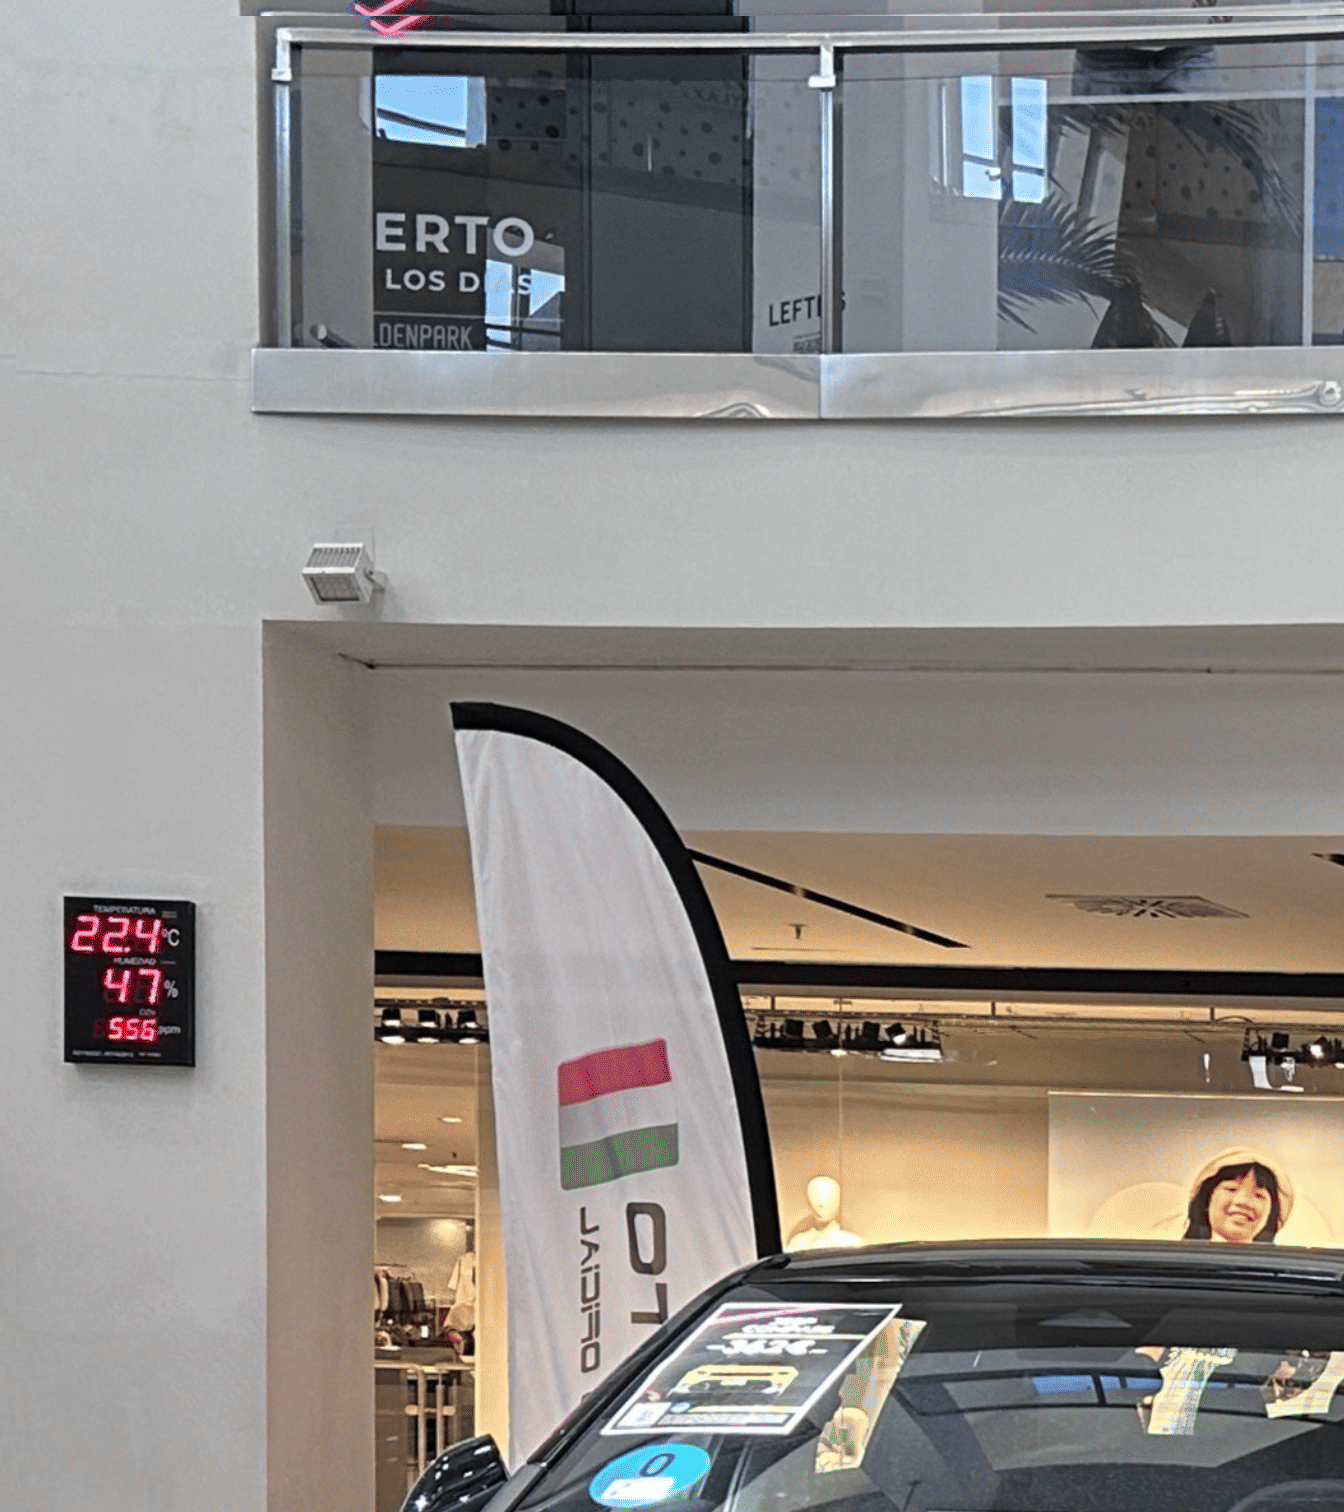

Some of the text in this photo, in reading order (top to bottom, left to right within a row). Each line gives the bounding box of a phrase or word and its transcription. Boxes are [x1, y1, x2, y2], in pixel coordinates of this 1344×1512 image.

[375, 212, 535, 257] ERTO
[386, 268, 532, 296] LOS DS
[769, 292, 846, 327] LEFTI
[374, 322, 473, 350] DENPARK
[93, 904, 156, 915] TEMPERATURA
[71, 915, 162, 954] 22.4
[104, 968, 162, 1005] 47
[108, 1016, 158, 1042] 556
